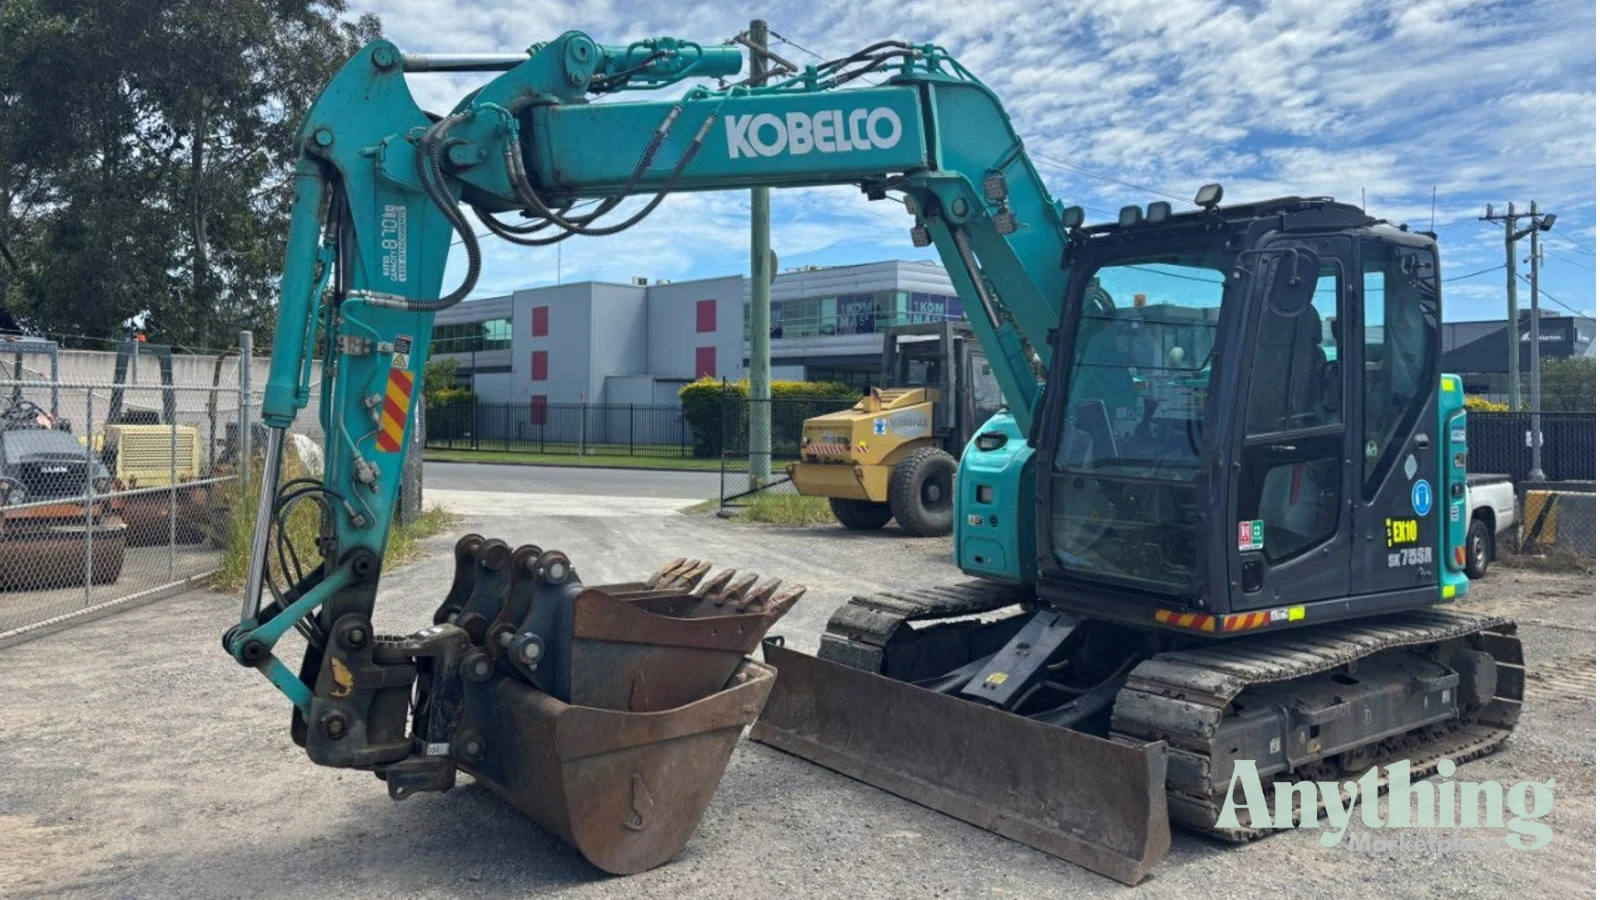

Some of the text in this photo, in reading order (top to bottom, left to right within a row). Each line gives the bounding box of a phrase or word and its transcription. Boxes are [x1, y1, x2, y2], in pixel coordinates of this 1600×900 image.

[725, 107, 902, 159] KOBELCO
[382, 255, 390, 276] RATED
[390, 251, 398, 282] CAPACITY
[1393, 520, 1417, 542] EX10
